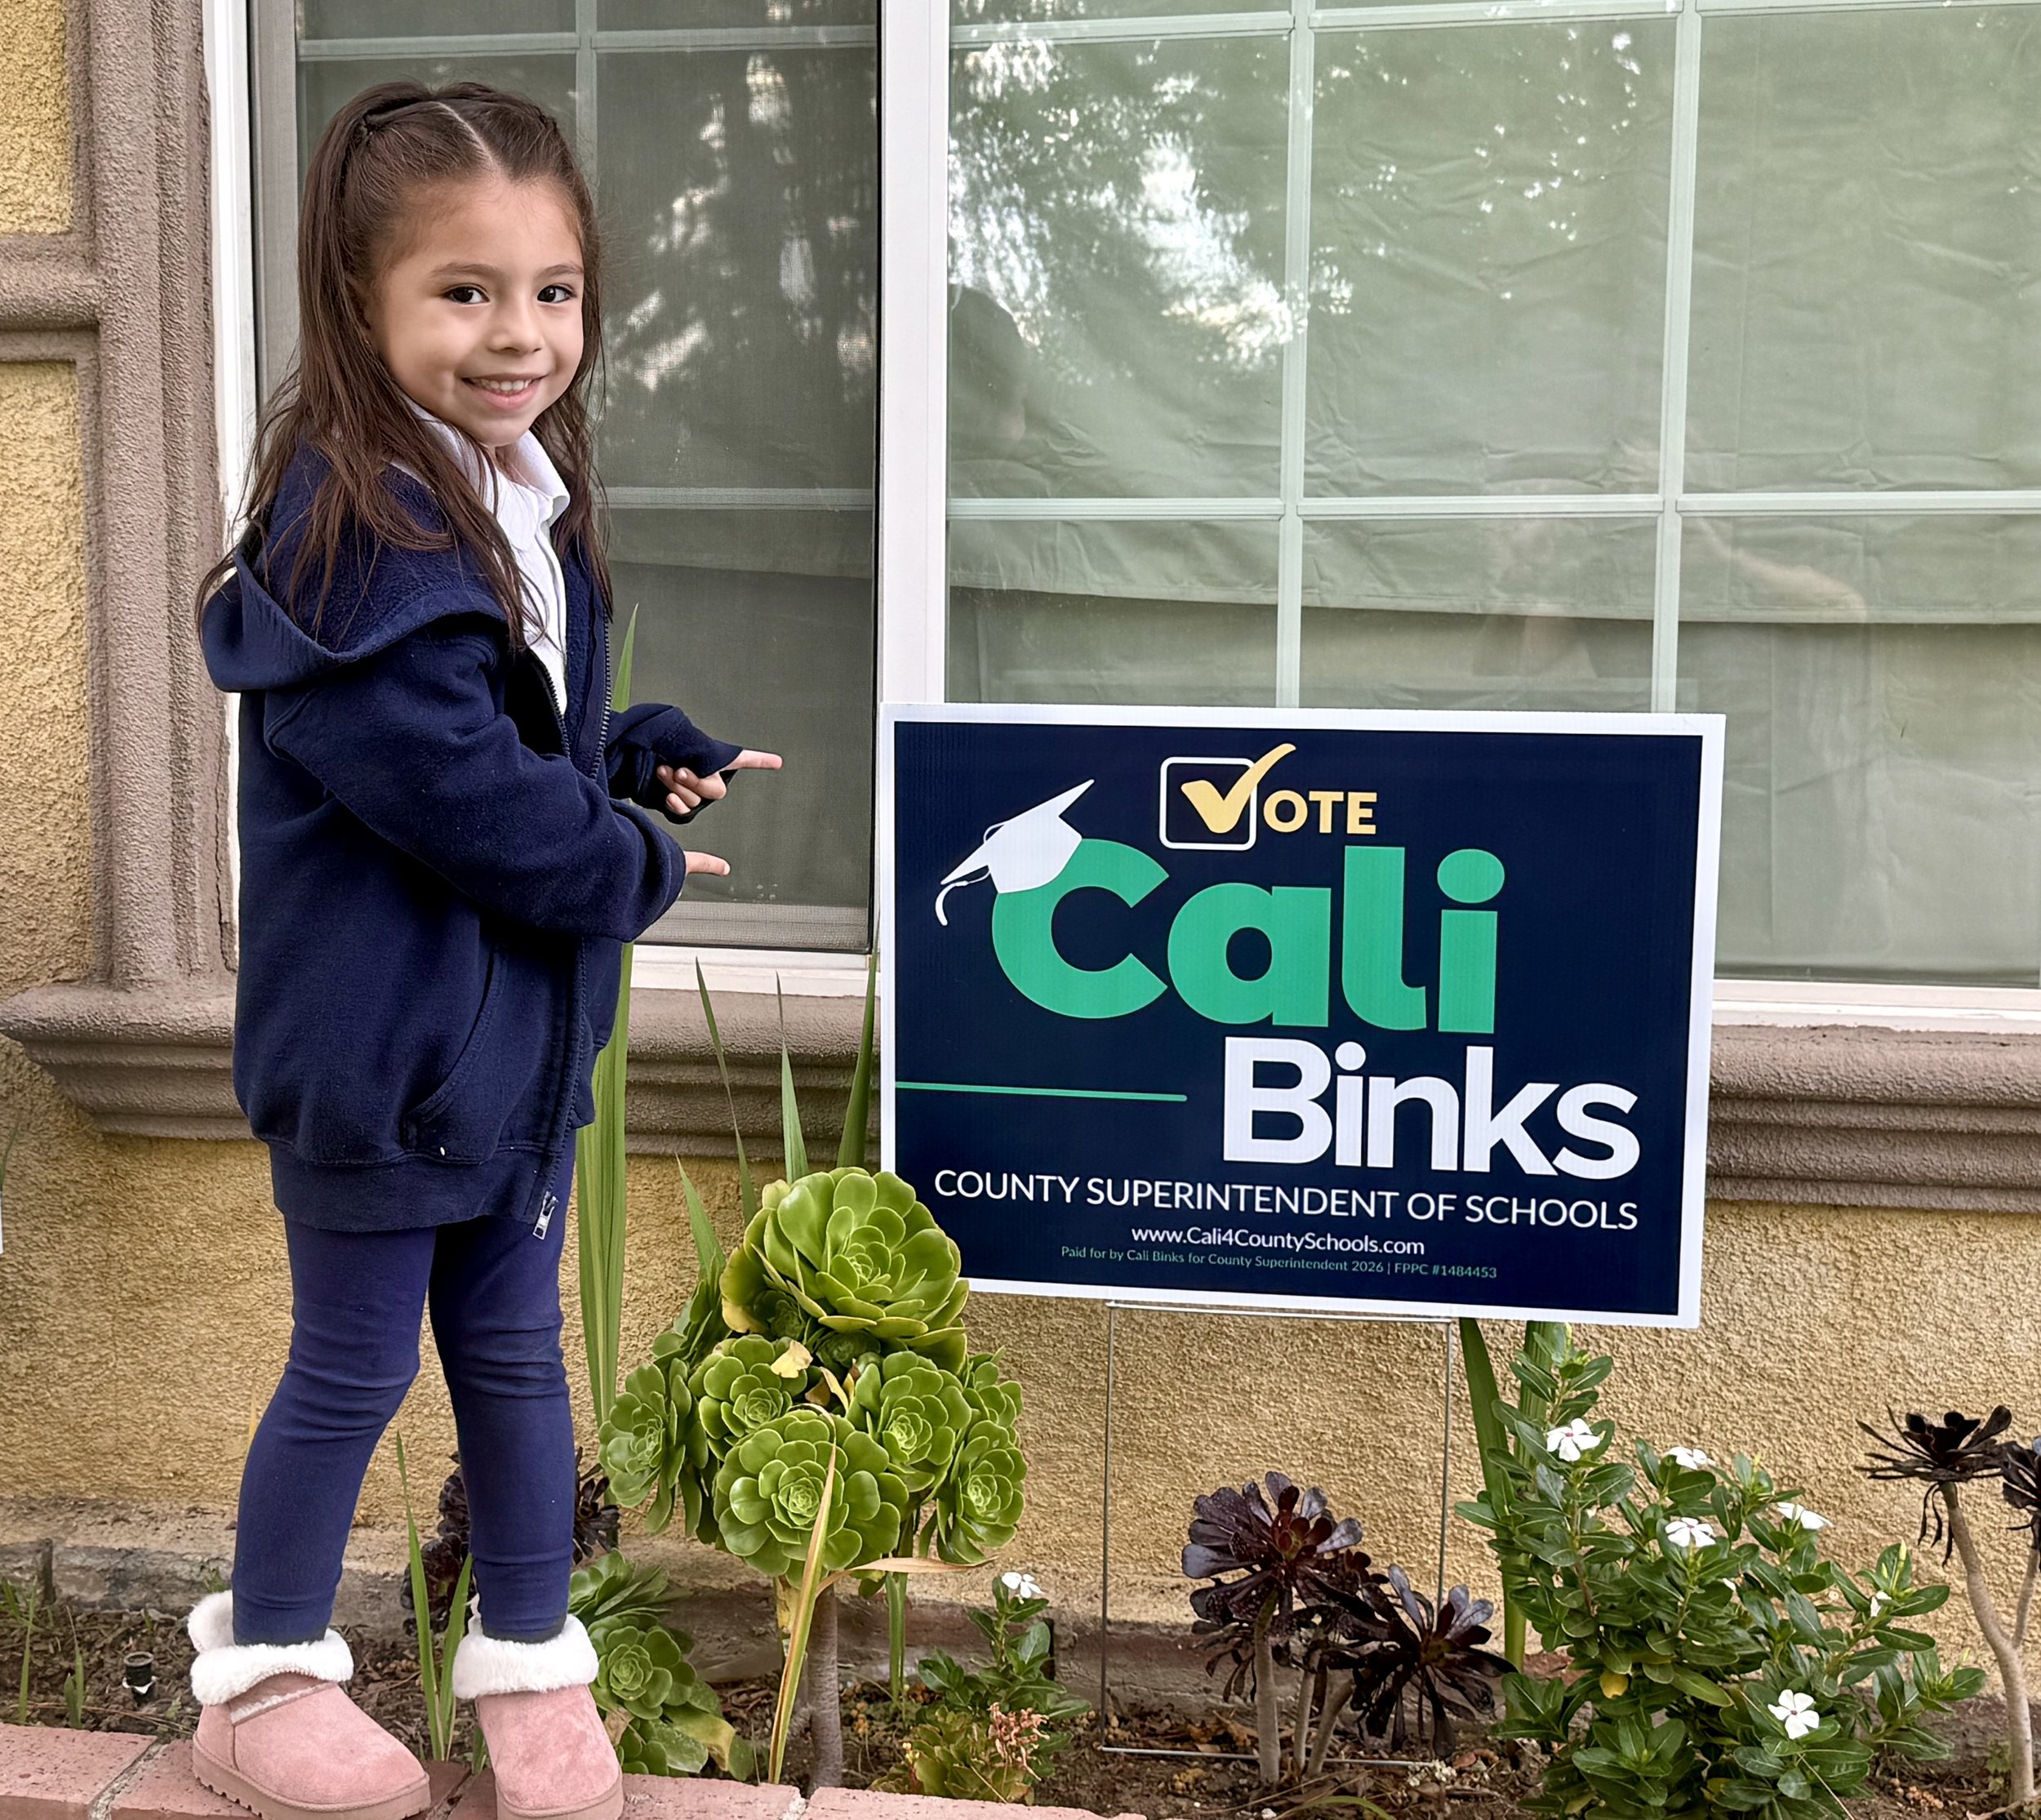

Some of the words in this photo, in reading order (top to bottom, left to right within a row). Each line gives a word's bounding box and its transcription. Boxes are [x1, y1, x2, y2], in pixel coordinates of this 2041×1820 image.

[991, 838, 1506, 1035] Cali
[1222, 1035, 1642, 1181] Binks
[934, 1168, 1081, 1204] COUNTY
[1086, 1177, 1400, 1219] SUPERINTENDENT
[1407, 1192, 1458, 1221] OF
[1465, 1195, 1639, 1230] SCHOOLS
[1061, 1245, 1087, 1258] Paid
[1089, 1247, 1107, 1259] for
[1109, 1248, 1124, 1262] by
[1126, 1249, 1149, 1262] Cali
[1152, 1250, 1185, 1263] Binks
[1188, 1252, 1206, 1264] for
[1207, 1253, 1252, 1268] County
[1254, 1255, 1349, 1271] Superintendent
[1351, 1260, 1385, 1273] 2026
[1394, 1262, 1430, 1275] FPPC
[1431, 1264, 1498, 1279] #1484453
[1131, 1226, 1425, 1256] www.Cali4CountySchools.com
